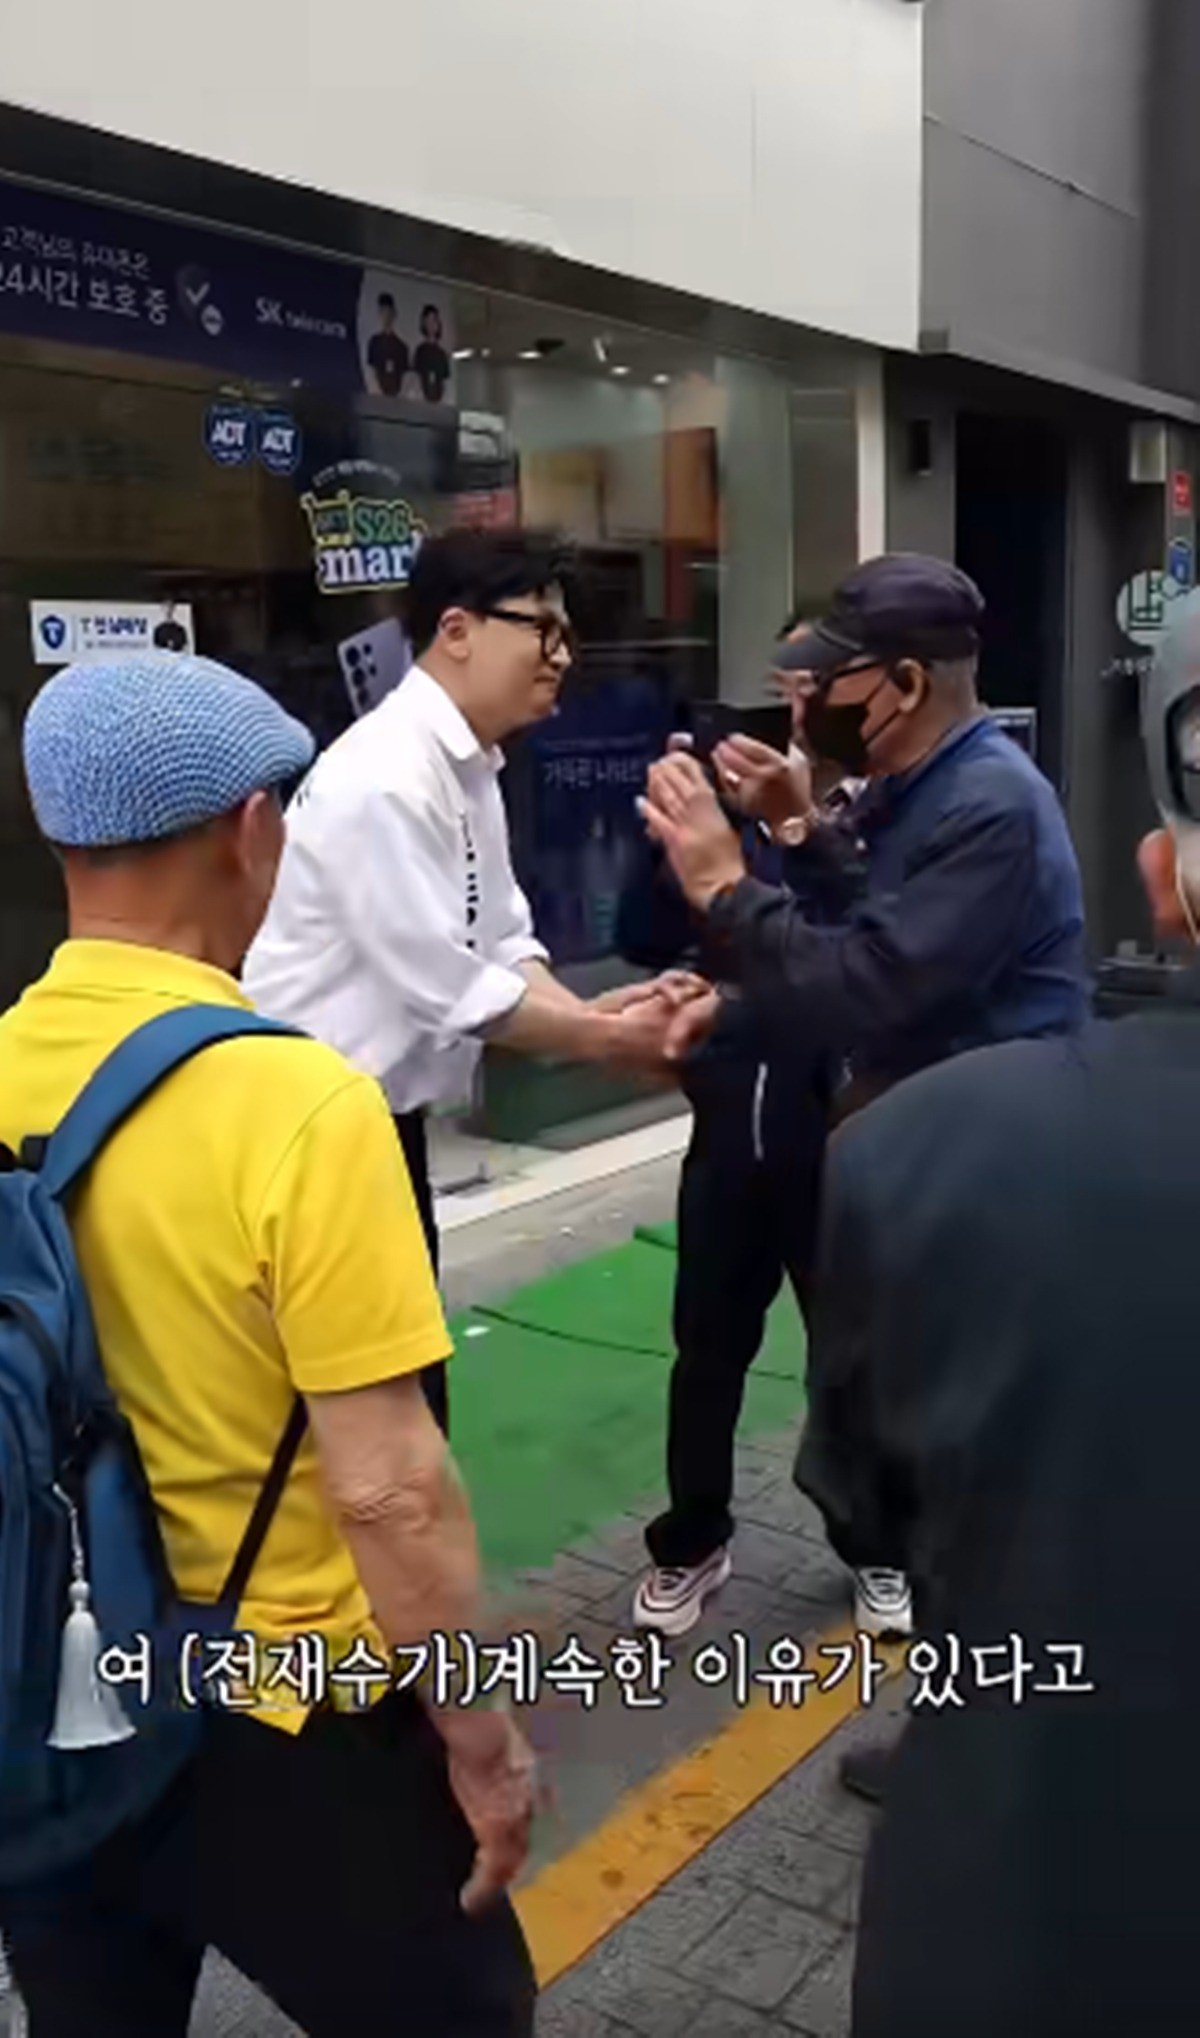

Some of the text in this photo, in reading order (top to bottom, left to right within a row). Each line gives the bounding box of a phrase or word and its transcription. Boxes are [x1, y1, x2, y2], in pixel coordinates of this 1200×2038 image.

[87, 278, 141, 318] 보호
[143, 286, 170, 326] 중
[255, 297, 284, 327] SK
[211, 420, 246, 447] ADT
[354, 505, 411, 546] S26
